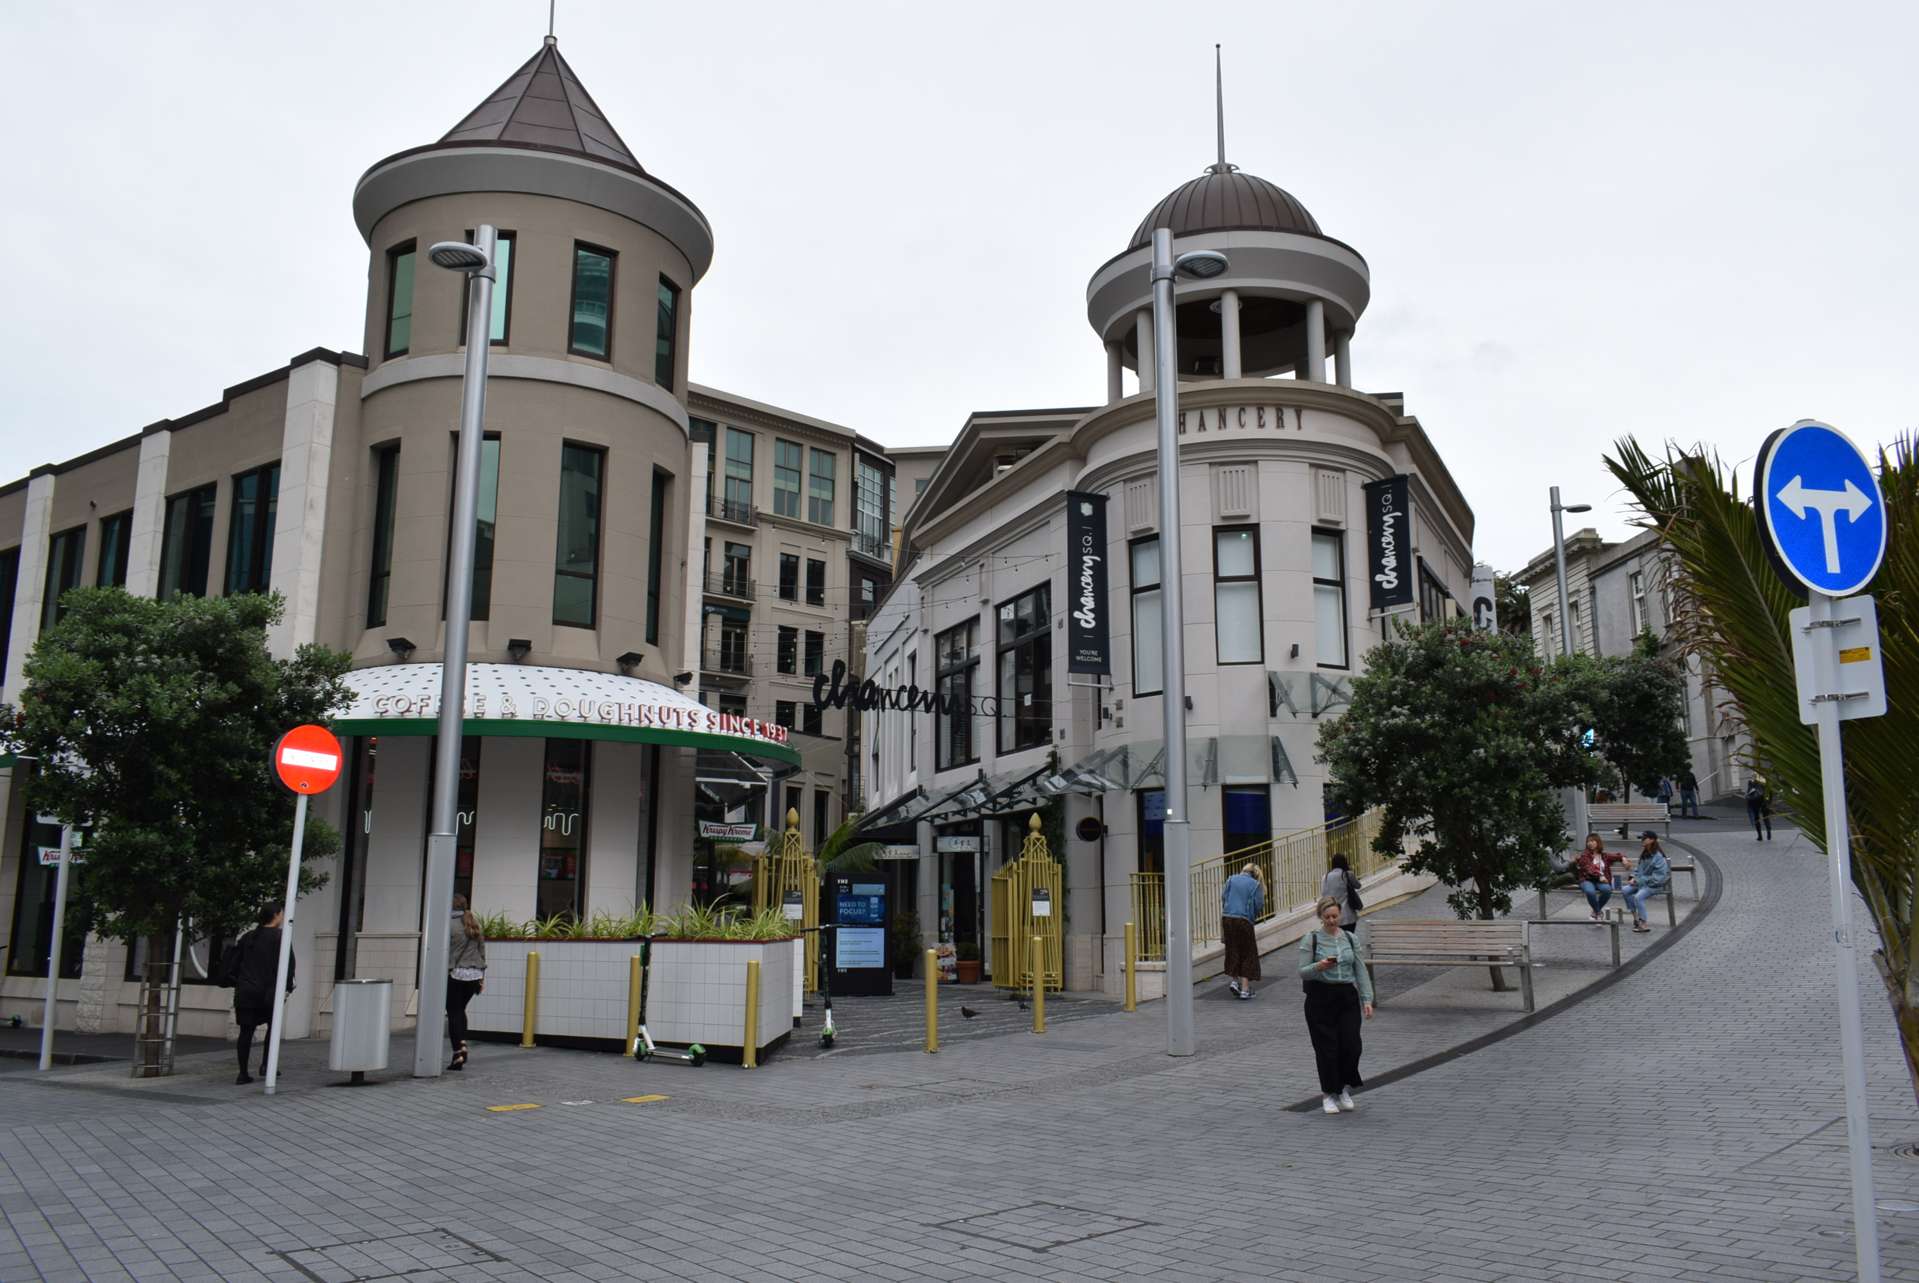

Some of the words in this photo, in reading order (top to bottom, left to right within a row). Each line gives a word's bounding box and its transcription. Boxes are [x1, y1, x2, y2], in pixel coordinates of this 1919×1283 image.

[1178, 407, 1303, 435] HANCERY
[1375, 512, 1402, 589] chancery
[1073, 555, 1101, 629] chancery
[1075, 655, 1102, 663] WELCOME
[373, 694, 487, 716] COFE
[499, 695, 518, 716] &
[532, 696, 699, 730] DOUGHNUTS
[706, 712, 761, 736] SINCE
[765, 722, 789, 742] 1937
